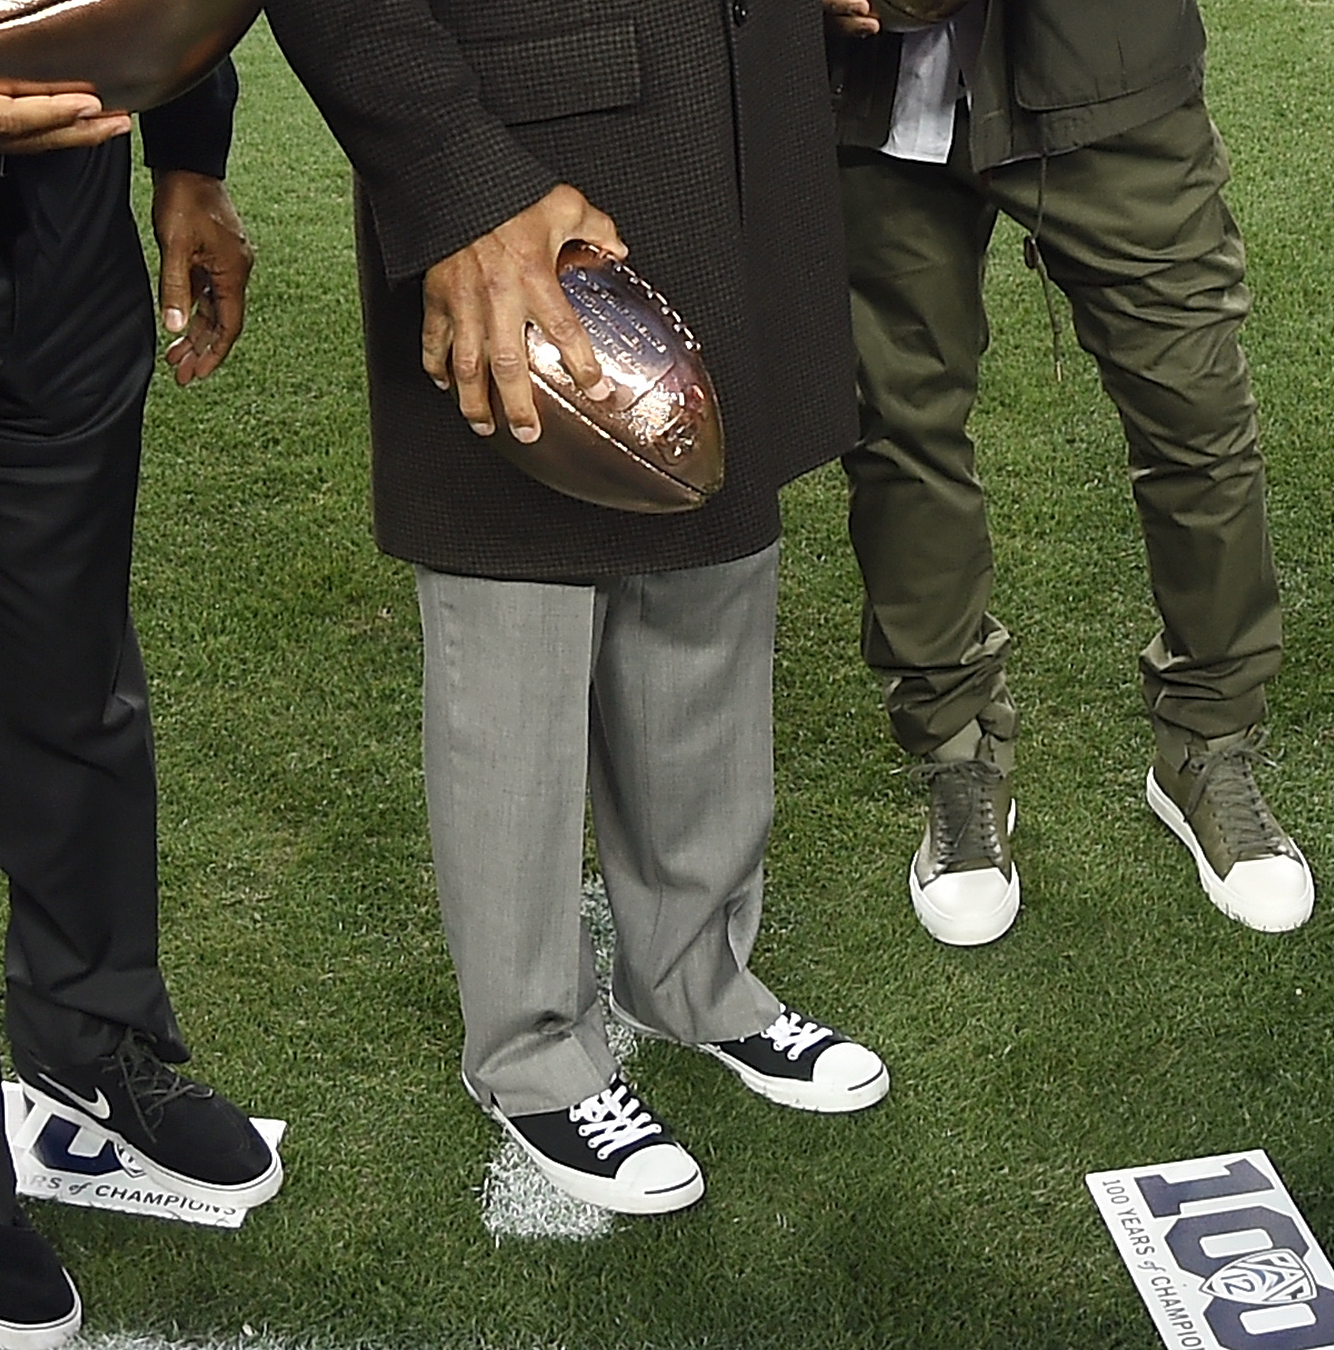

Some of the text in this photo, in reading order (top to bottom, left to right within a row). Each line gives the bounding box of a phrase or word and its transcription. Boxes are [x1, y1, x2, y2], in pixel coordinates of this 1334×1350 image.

[68, 1181, 92, 1196] of
[1102, 1179, 1130, 1205] 100
[1117, 1207, 1156, 1256] YEARS
[1150, 1276, 1206, 1350] CHAMPIO
